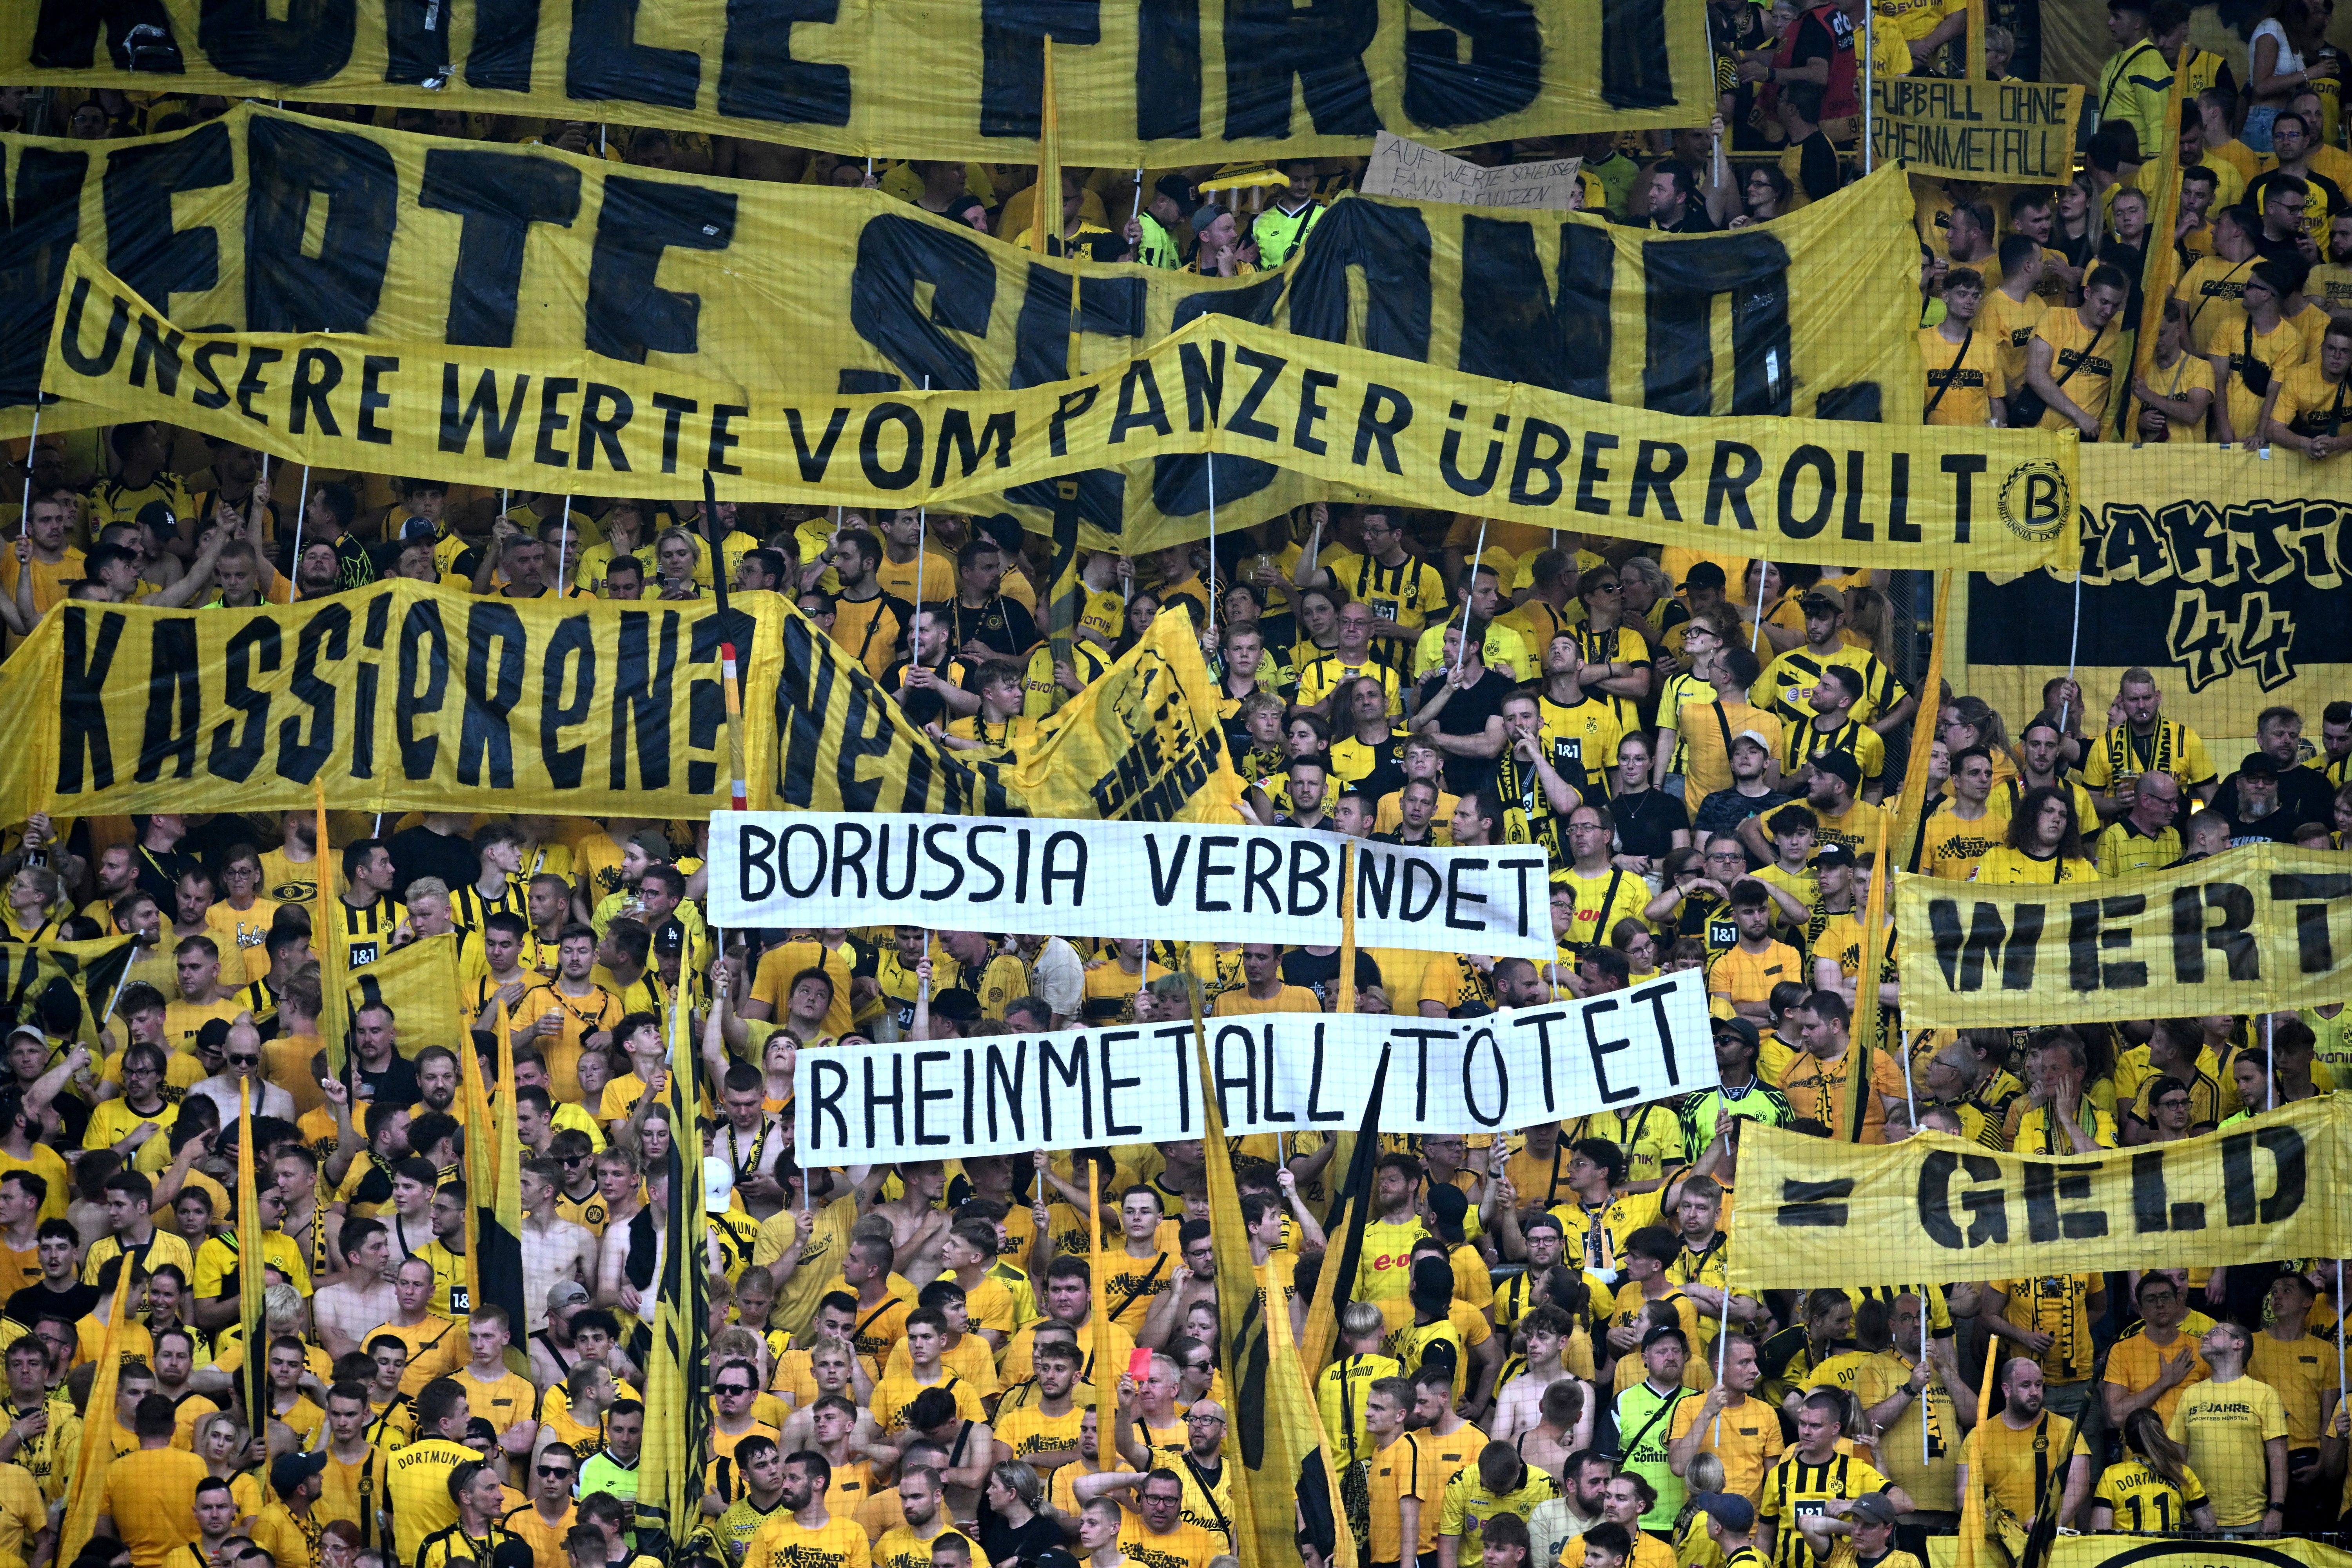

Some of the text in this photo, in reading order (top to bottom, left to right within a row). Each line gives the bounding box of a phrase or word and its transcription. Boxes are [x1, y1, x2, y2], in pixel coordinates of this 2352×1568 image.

[1999, 85, 2067, 125] OHNE
[1212, 164, 1267, 181] FRAUENHANDTASCHE
[1382, 140, 1582, 190] AUF WERTE SCHEISSEN
[1392, 167, 1447, 199] FANS
[61, 276, 1987, 544] UNSERE WERTE VOM PANZER ÜBERROLLT
[1998, 501, 2032, 541] BRITANNIA
[2040, 500, 2070, 541] DORMUND
[1403, 584, 1415, 595] BVB
[1486, 644, 1499, 652] BVB
[2167, 588, 2298, 694] 44
[1586, 721, 1597, 730] BVB
[1557, 743, 1579, 759] 1&1
[1321, 802, 1334, 811] BVB
[1816, 830, 1865, 845] ESTFALEN
[740, 822, 1544, 937] BORUSSIA VERBINDET
[2060, 870, 2072, 878] BVB
[381, 920, 393, 929] BVB
[668, 927, 678, 940] LA
[1712, 927, 1736, 942] 1&1
[1929, 873, 2352, 992] WERT
[352, 948, 375, 965] 1&1
[990, 989, 1001, 998] BVB
[700, 998, 711, 1008] BVB
[898, 1007, 914, 1024] &1
[811, 981, 1680, 1150] RHEINMETALL TÖTET
[1755, 1112, 1766, 1120] BVB
[1917, 1125, 2306, 1249] GELD
[589, 1208, 601, 1219] BVB
[1613, 1212, 1625, 1220] BVB
[452, 1293, 470, 1308] 1&
[1330, 1366, 1374, 1381] DOTMUND
[2207, 1403, 2250, 1414] JAHRE
[1026, 1433, 1079, 1452] WESTFALEN
[1340, 1437, 1357, 1450] RES
[1831, 1481, 1843, 1489] BVB
[1519, 1503, 1530, 1512] BVB
[2125, 1494, 2173, 1531] 11
[784, 1543, 845, 1563] WESTFALEN
